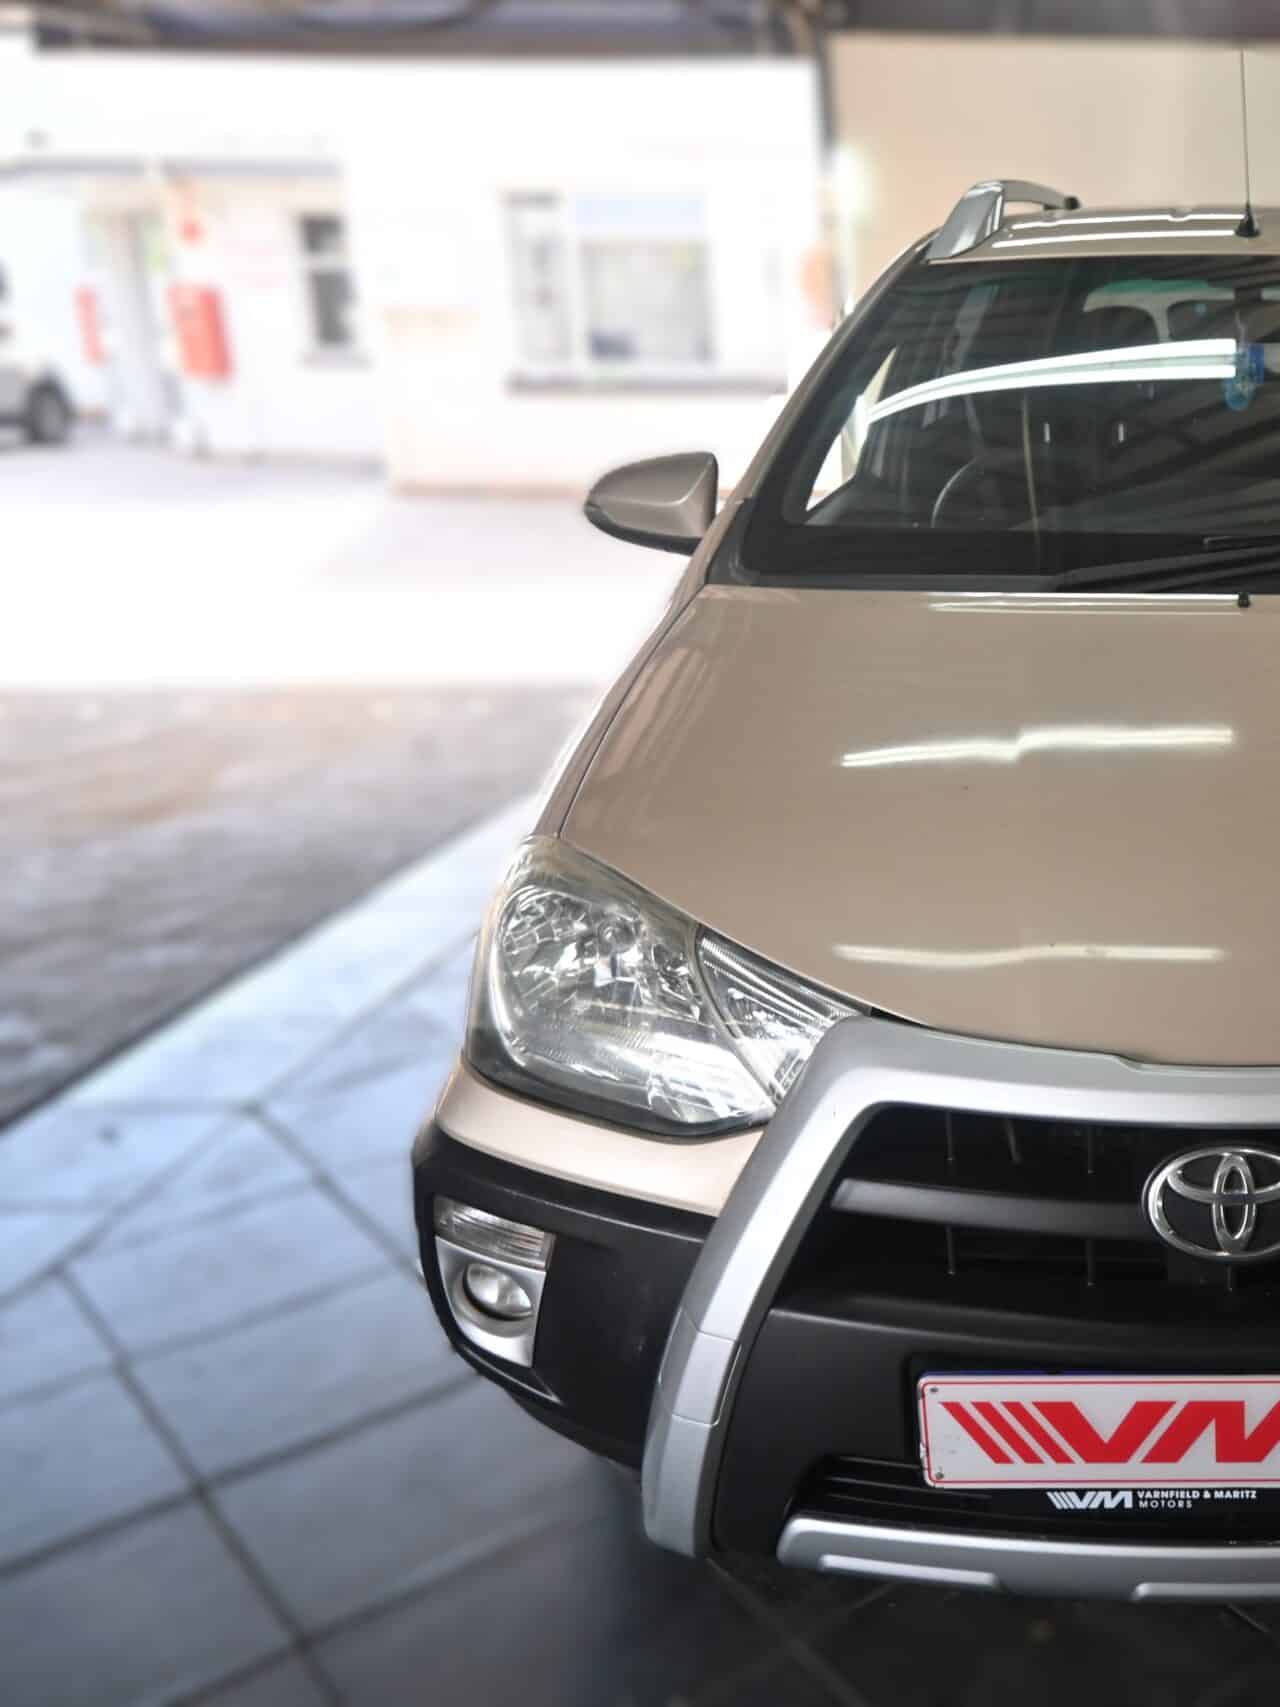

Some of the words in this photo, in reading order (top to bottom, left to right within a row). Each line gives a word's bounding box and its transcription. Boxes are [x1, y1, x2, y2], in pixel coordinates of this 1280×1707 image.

[1066, 1490, 1134, 1509] VM
[1137, 1490, 1200, 1499] VARNFIELD
[1202, 1490, 1212, 1499] &
[1213, 1490, 1257, 1499] MARITZ
[1139, 1500, 1193, 1509] MOTORS
